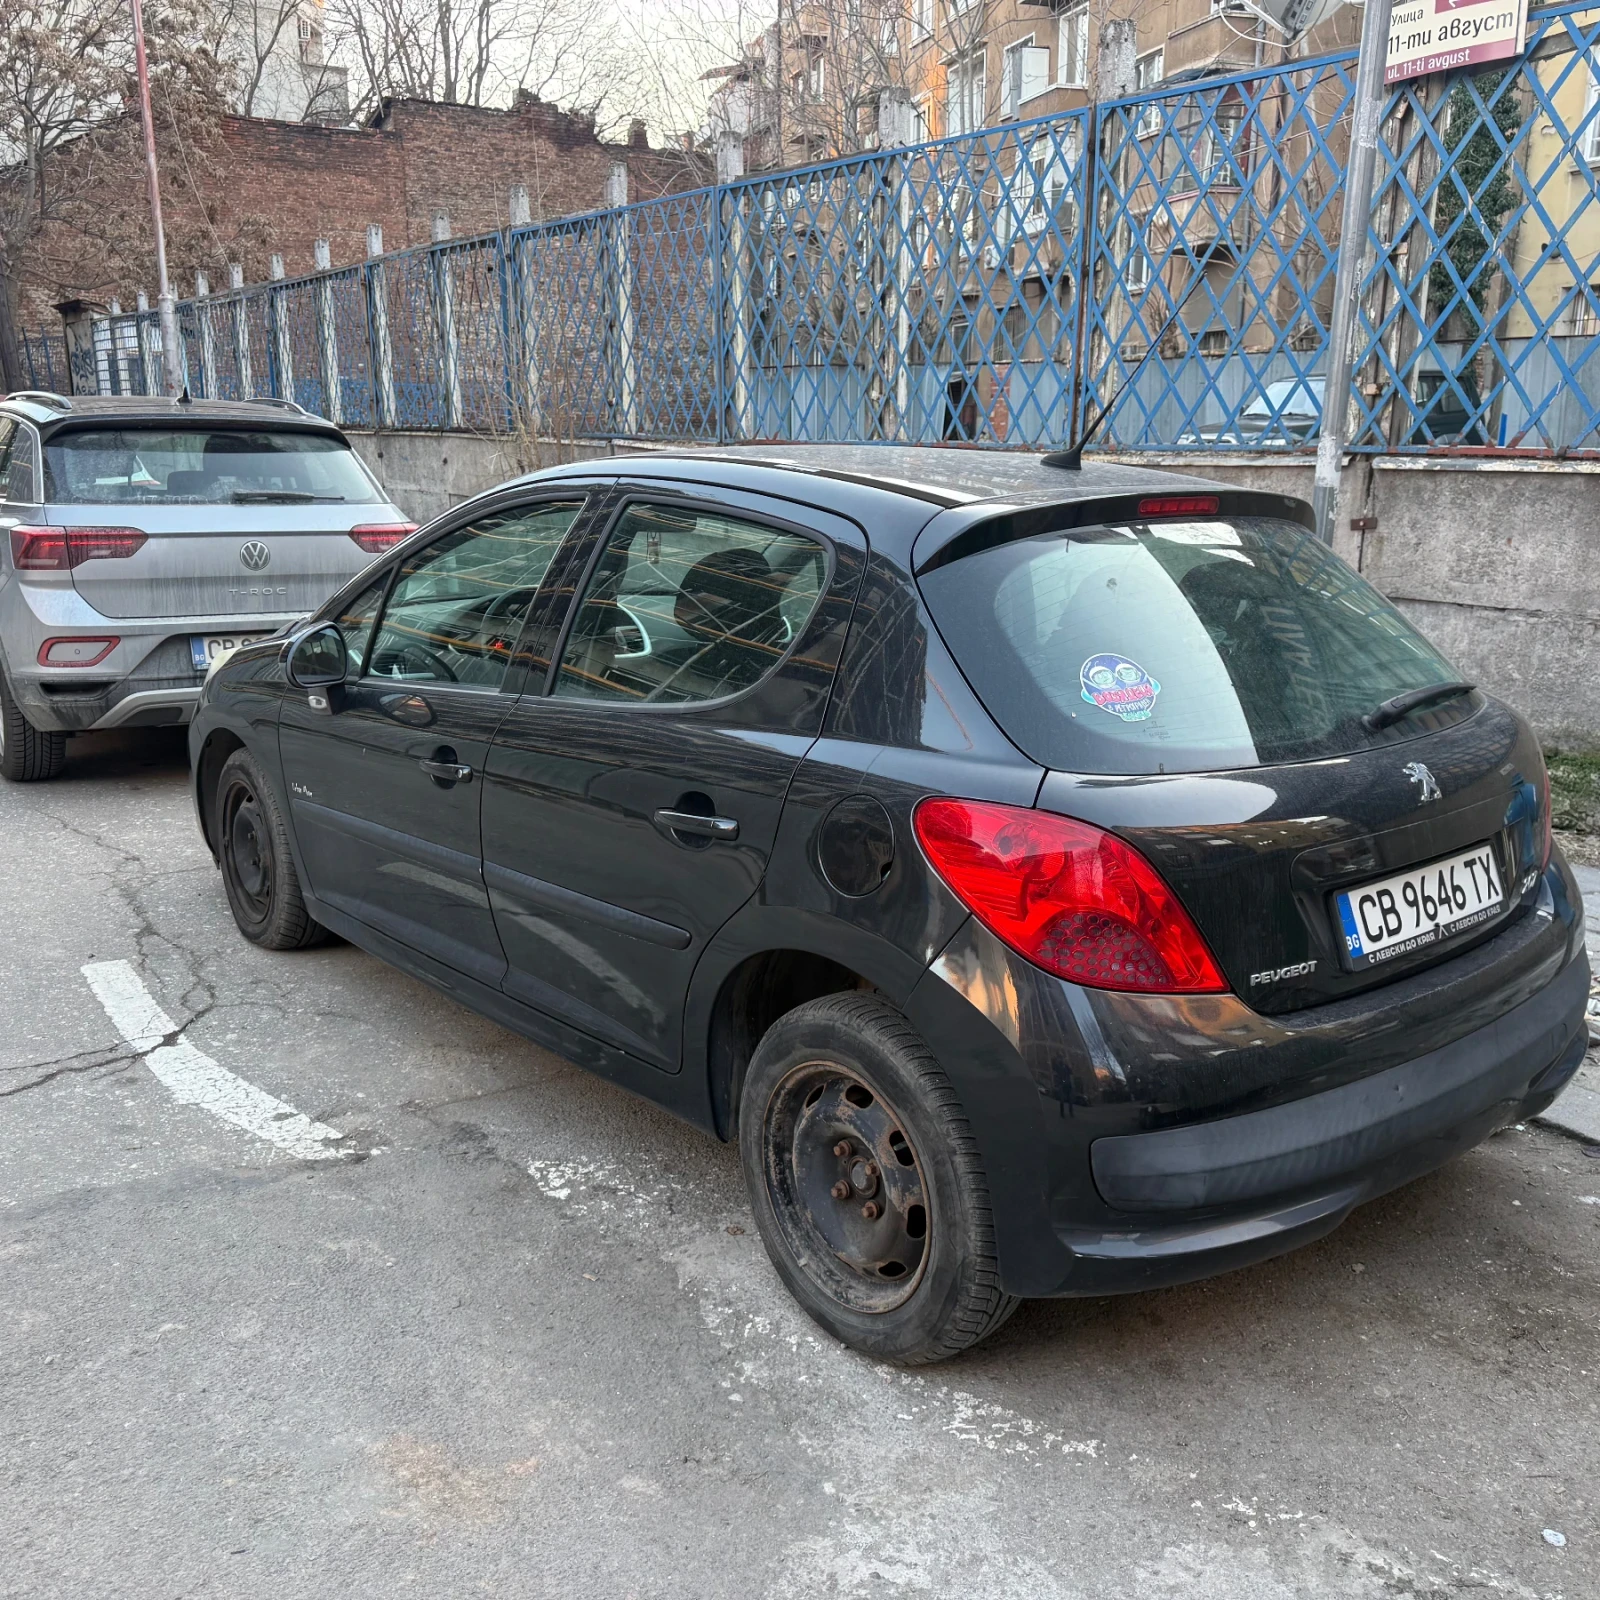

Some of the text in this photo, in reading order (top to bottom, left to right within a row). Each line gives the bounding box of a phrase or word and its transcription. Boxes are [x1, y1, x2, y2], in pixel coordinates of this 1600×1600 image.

[1391, 8, 1424, 27] Улица
[1388, 11, 1514, 55] 11-ти август
[1387, 48, 1470, 80] ul. 11-ti avgust
[228, 587, 287, 596] T-ROC
[1358, 888, 1403, 943] CB
[1402, 865, 1466, 928] 9646
[1463, 853, 1500, 904] TX
[1376, 943, 1406, 961] ЛЕВСКИ
[1250, 960, 1318, 987] PEUGEOT
